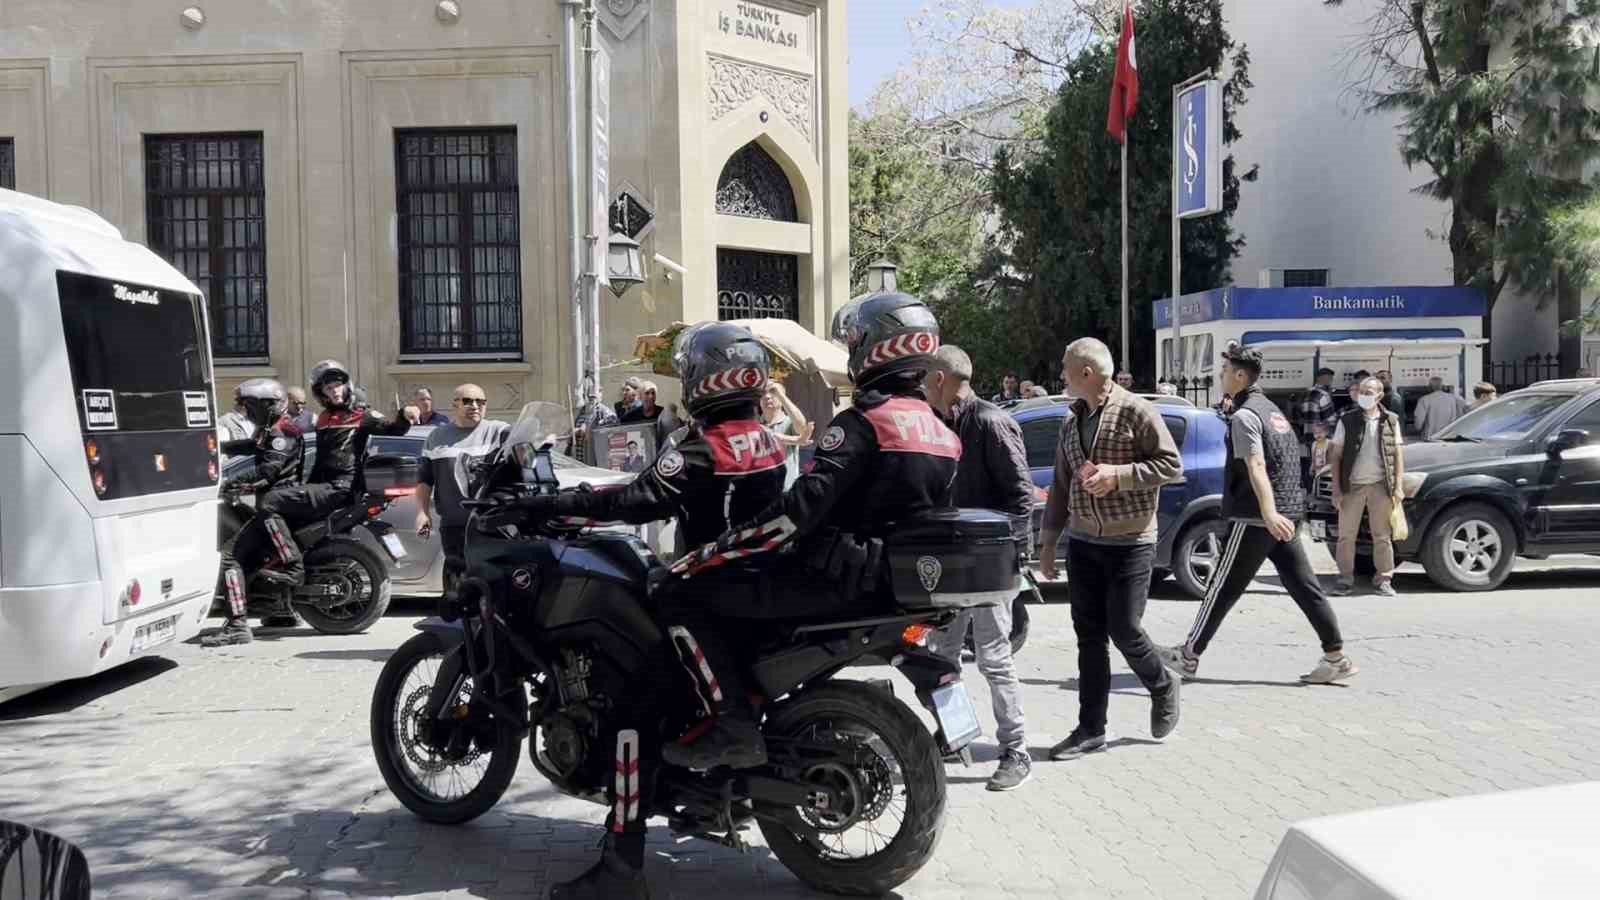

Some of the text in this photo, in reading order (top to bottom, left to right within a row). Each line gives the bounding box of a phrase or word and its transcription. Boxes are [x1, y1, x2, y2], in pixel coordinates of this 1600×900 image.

[737, 3, 780, 25] TÜRKİYE
[735, 20, 797, 48] BANKASI
[1313, 295, 1405, 310] Bankamatik
